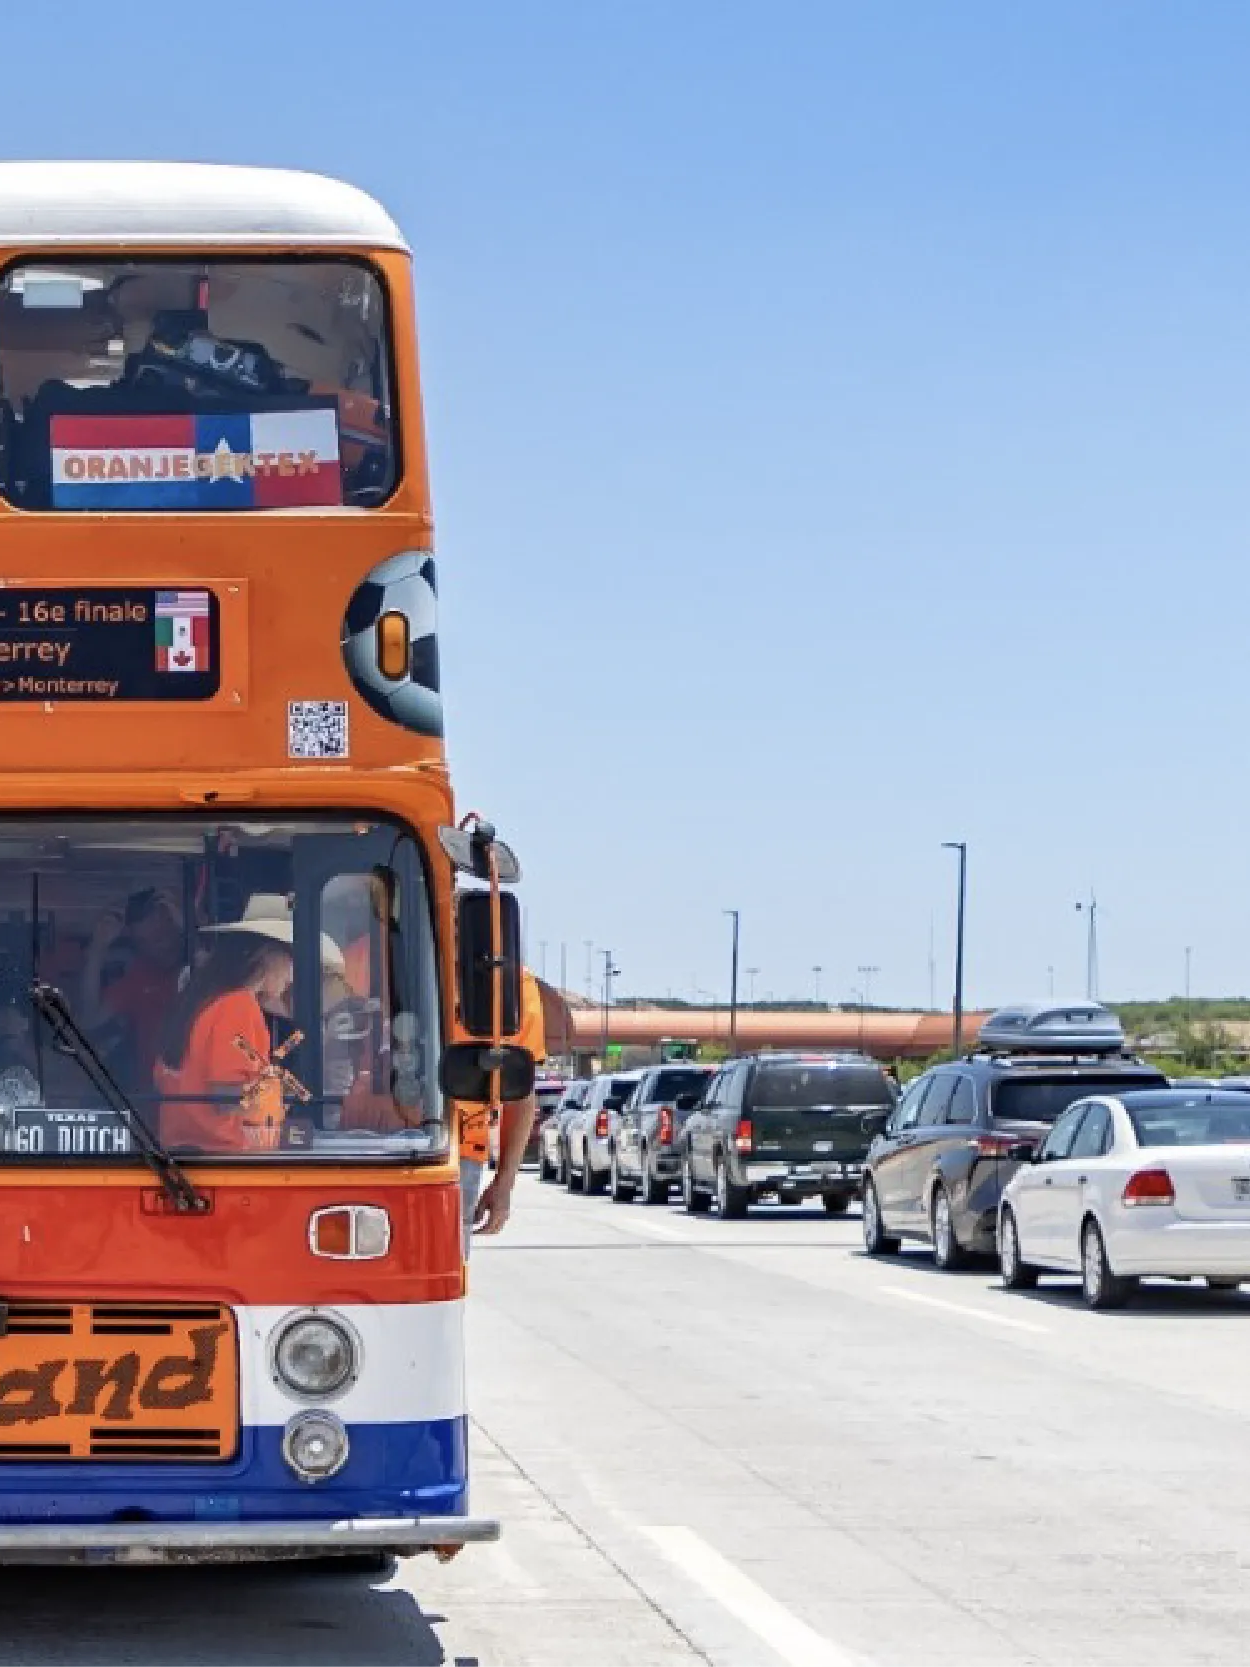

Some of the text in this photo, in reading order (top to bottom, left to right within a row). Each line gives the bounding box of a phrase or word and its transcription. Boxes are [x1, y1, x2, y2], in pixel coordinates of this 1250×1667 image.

[18, 601, 66, 623] 16e
[74, 599, 147, 622] finale
[17, 1125, 128, 1153] GO DUTCH
